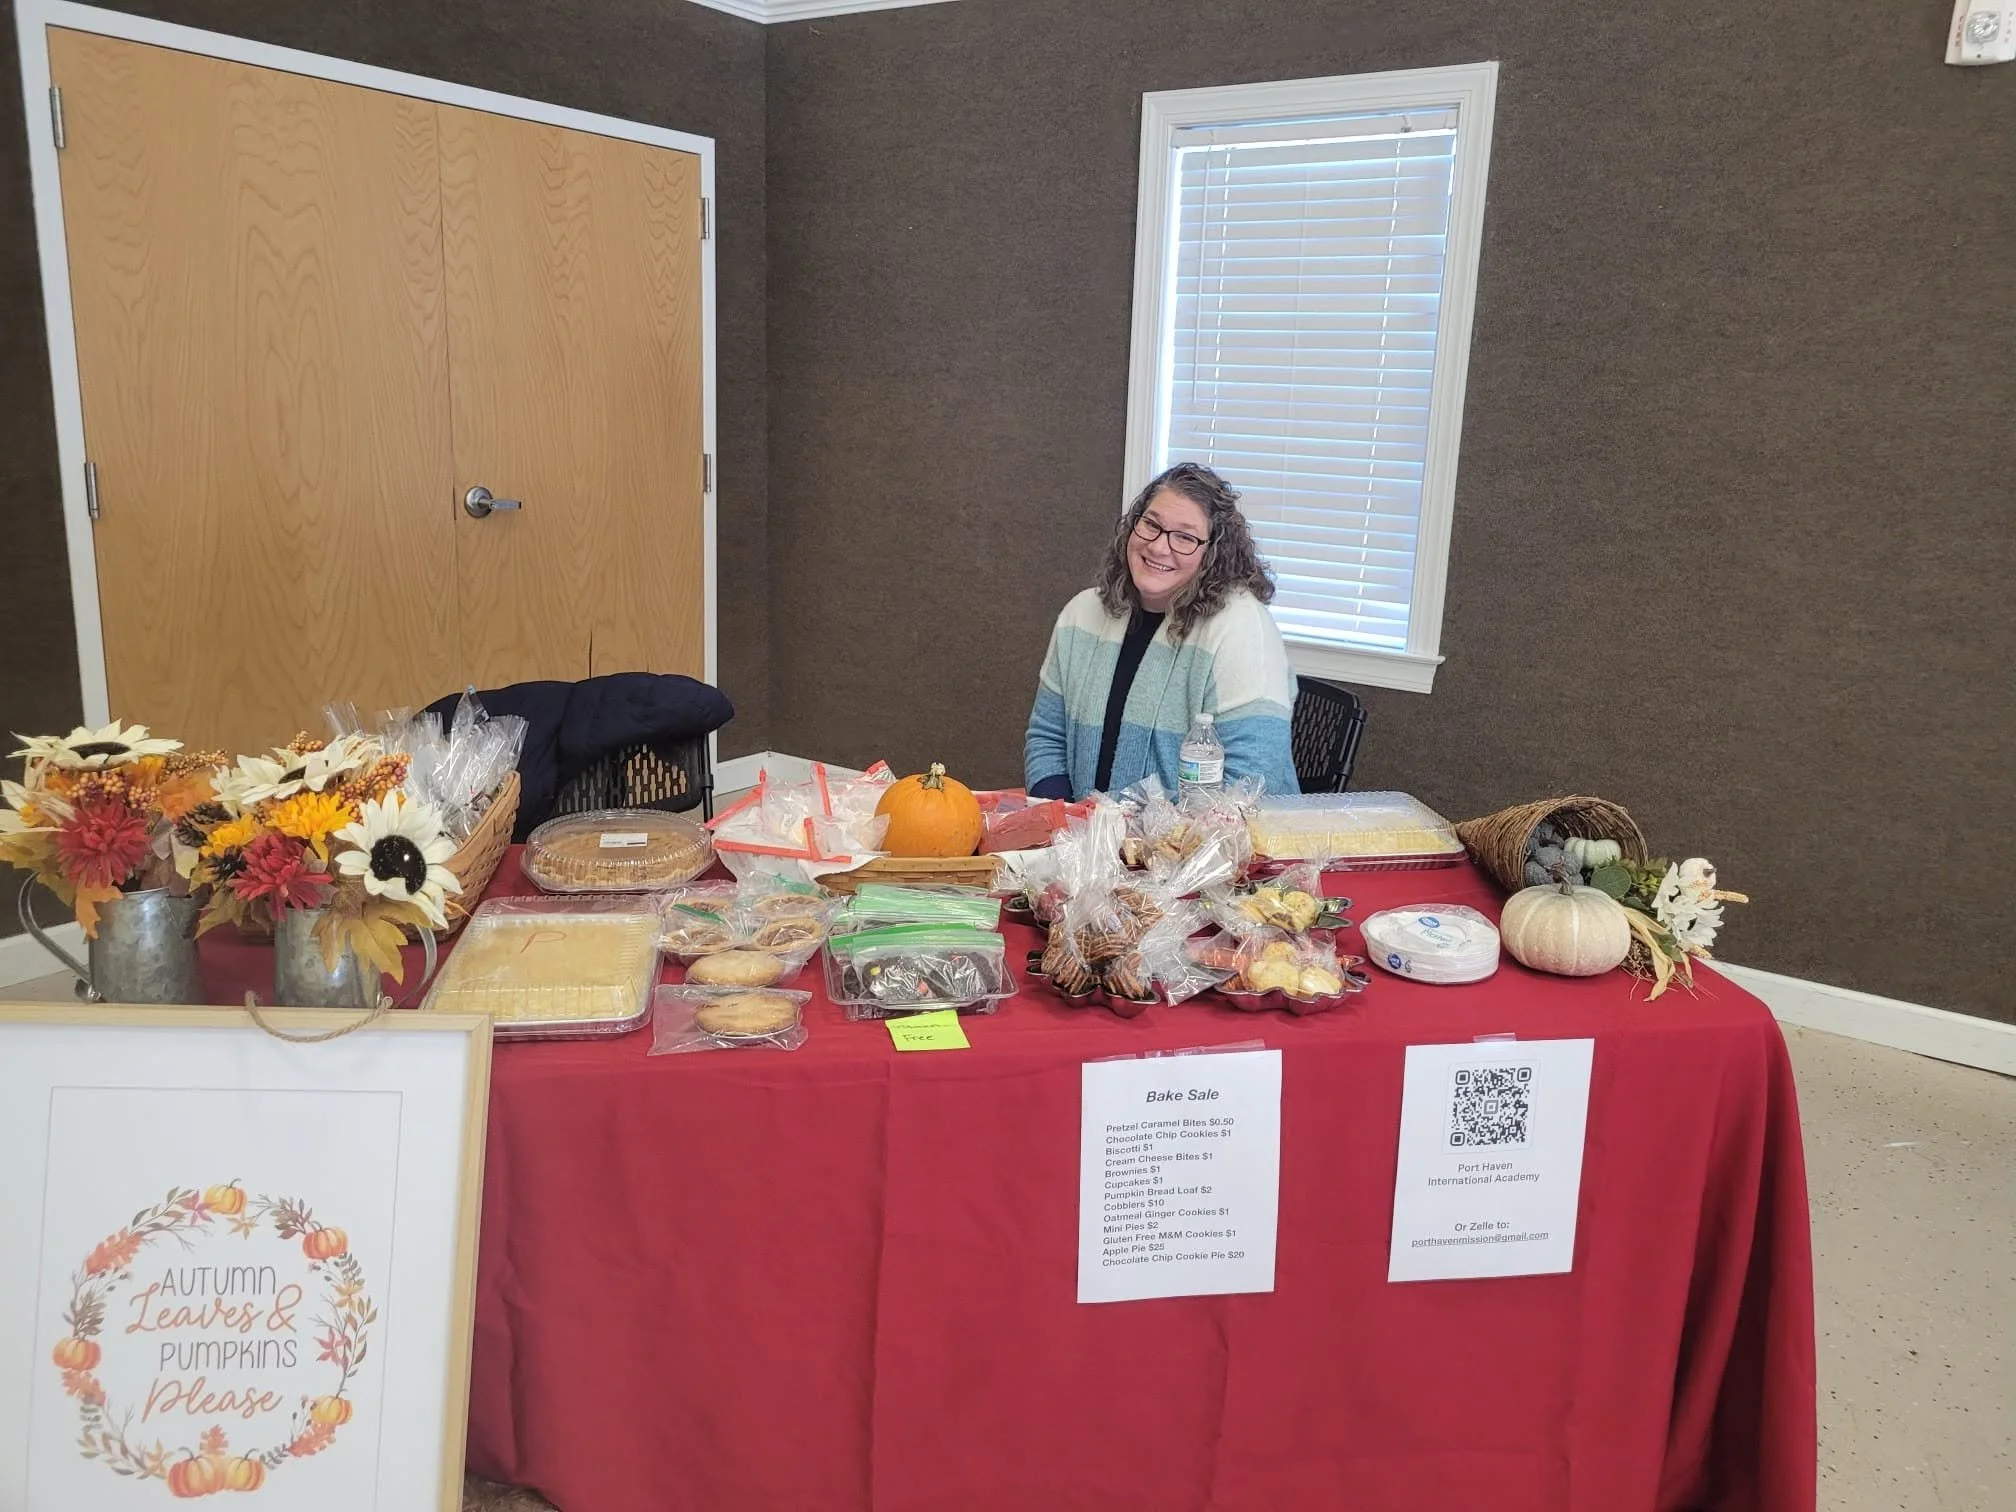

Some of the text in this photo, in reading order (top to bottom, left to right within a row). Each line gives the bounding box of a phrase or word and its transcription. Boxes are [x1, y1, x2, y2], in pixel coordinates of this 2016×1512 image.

[1146, 1089, 1219, 1103] Bake Sale
[1106, 1118, 1234, 1133] Pretzel Caramel Bites $0.50
[1106, 1129, 1231, 1144] Chocolate Chip Cookies $1
[1106, 1143, 1153, 1156] Biscotti $1
[1105, 1152, 1213, 1167] Cream Cheese Bites $1
[1105, 1165, 1160, 1178] Brownies $1
[1458, 1163, 1513, 1173] Port Haven
[1104, 1176, 1163, 1189] Cupcakes $1
[1428, 1172, 1540, 1186] International Academy
[1104, 1186, 1212, 1200] Pumpkin Bread Loaf $2
[1104, 1199, 1165, 1211] Cobblers $10
[1103, 1208, 1229, 1223] Oatmeal Ginger Cookies $1
[1103, 1221, 1158, 1234] Mini Pies $2
[1454, 1221, 1510, 1232] Or Zelle to:
[1103, 1236, 1133, 1245] Gluten
[1158, 1231, 1182, 1239] M&M
[1185, 1230, 1223, 1238] Cookies
[1226, 1229, 1236, 1238] $1
[1411, 1232, 1549, 1248] porthavenmission@gmail.com
[1102, 1243, 1165, 1257] Apple Pie $25
[1102, 1251, 1244, 1267] Chocolate Chip Cookie Pie $20
[160, 1266, 277, 1297] AUTUMN
[125, 1282, 303, 1334] Leaves &
[160, 1339, 298, 1371] PUMPKINS
[142, 1377, 284, 1423] Please
